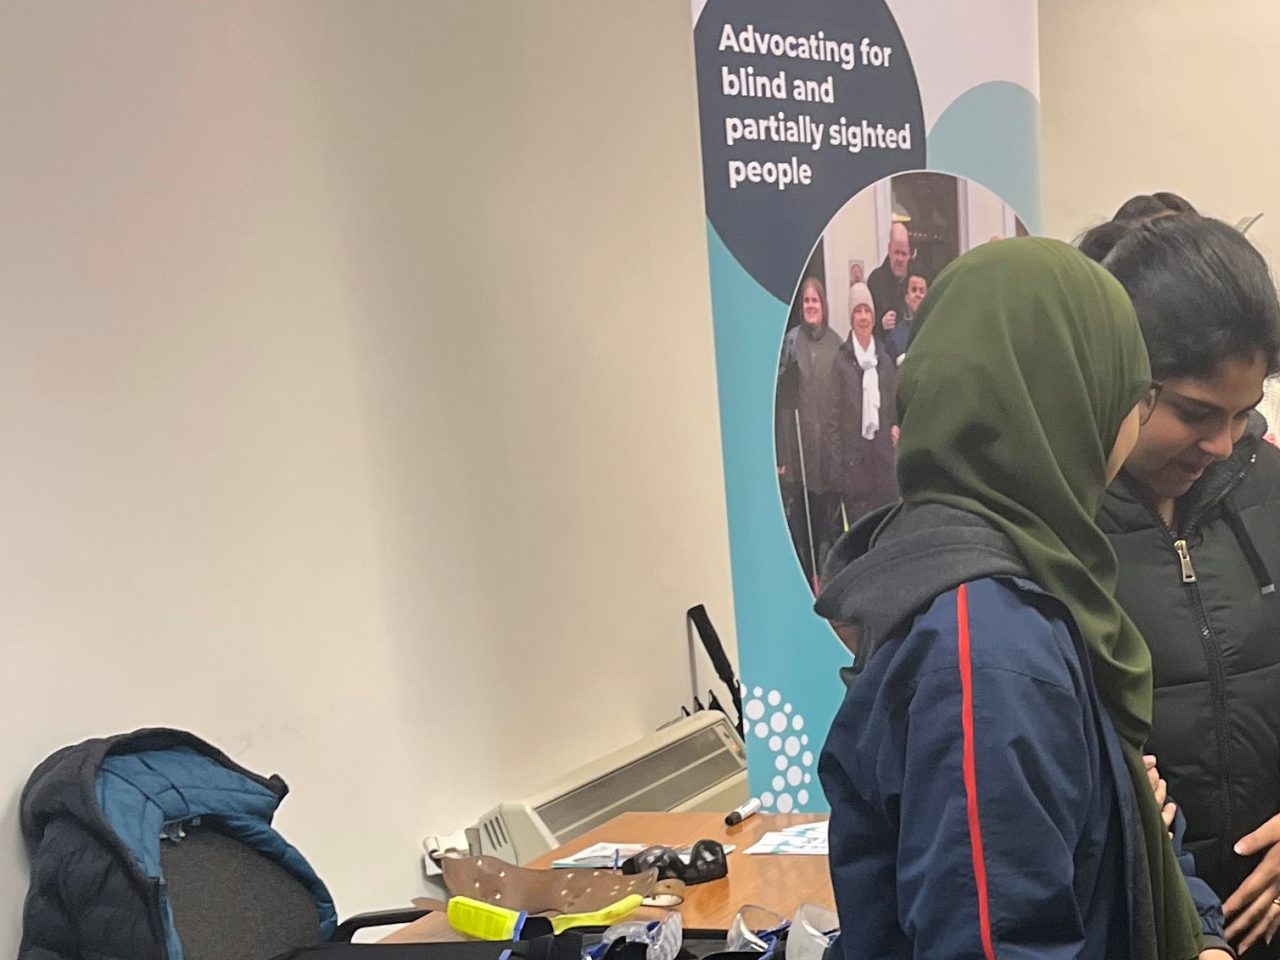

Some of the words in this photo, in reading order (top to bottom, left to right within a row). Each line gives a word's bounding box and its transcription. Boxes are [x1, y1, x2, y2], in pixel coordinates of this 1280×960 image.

[719, 24, 855, 70] Advocating
[860, 37, 892, 67] for
[722, 66, 787, 99] blind
[793, 76, 835, 103] and
[725, 111, 824, 150] partially
[829, 116, 911, 153] sighted
[728, 157, 812, 190] people
